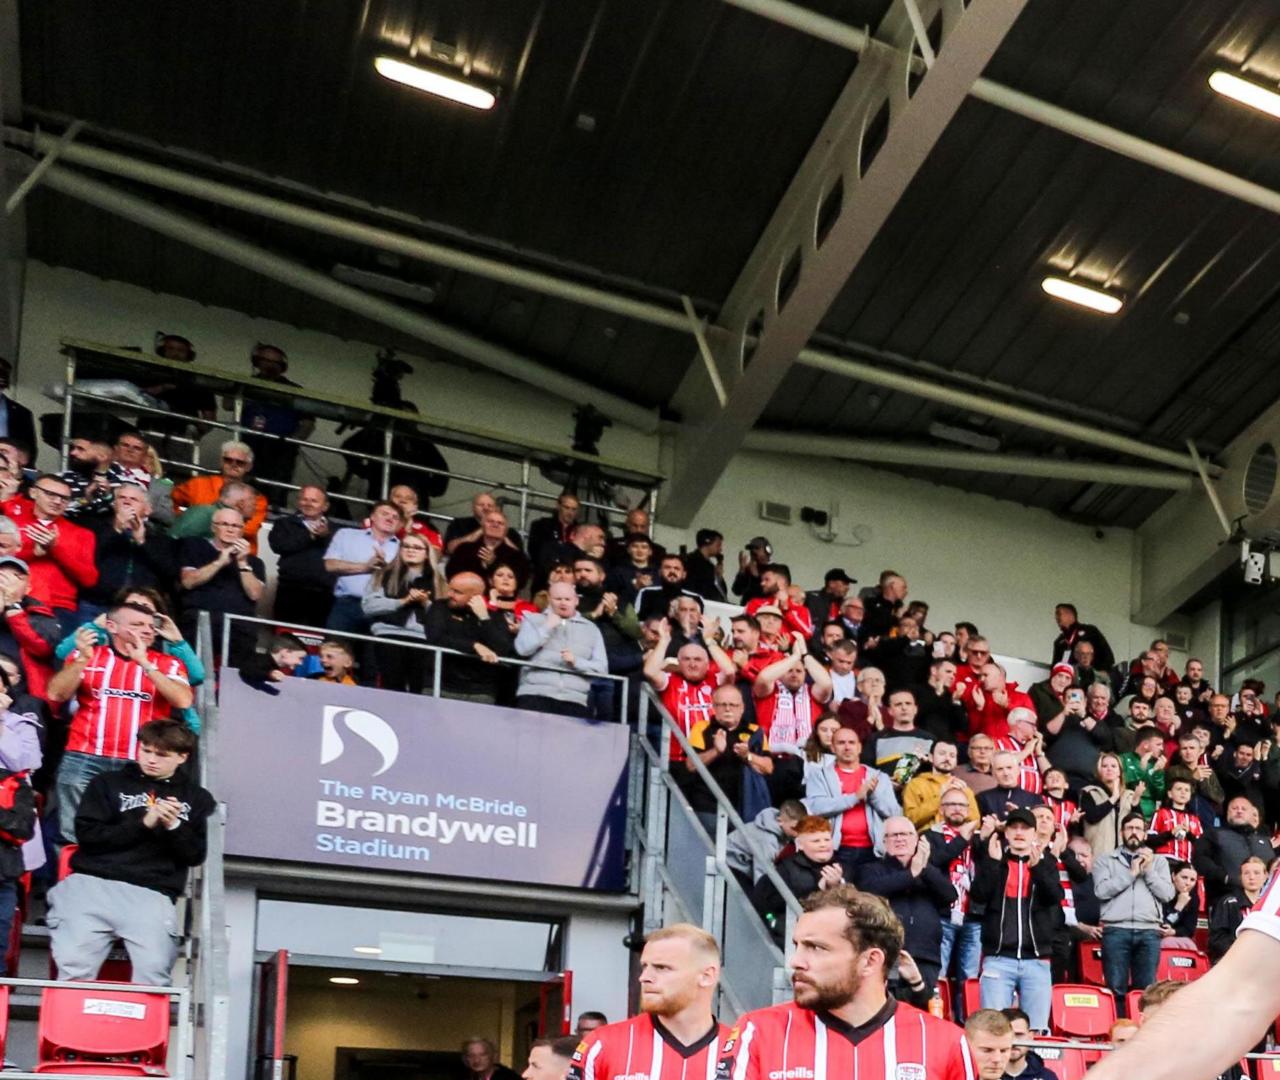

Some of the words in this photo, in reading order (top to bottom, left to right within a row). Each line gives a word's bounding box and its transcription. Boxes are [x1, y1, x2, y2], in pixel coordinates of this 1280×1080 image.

[319, 779, 364, 799] The
[371, 785, 429, 806] Ryan
[436, 793, 528, 817] McBride
[316, 799, 538, 848] Brandywell
[316, 833, 430, 861] Stadium
